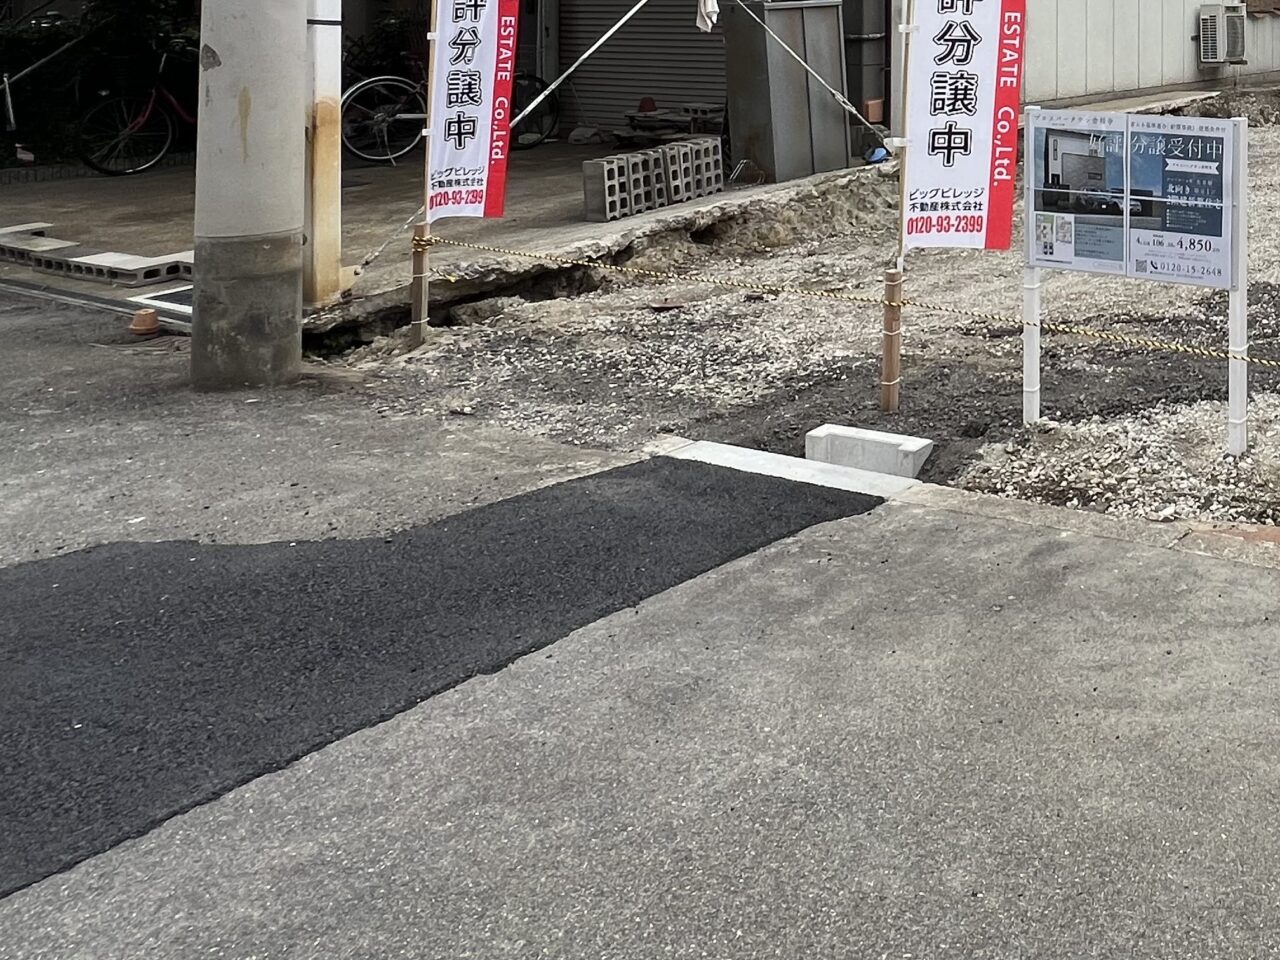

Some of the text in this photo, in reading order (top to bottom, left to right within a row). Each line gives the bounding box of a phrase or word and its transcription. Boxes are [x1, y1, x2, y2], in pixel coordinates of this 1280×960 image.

[497, 16, 515, 81] ESTATE
[1000, 13, 1020, 87] ESTATE
[993, 106, 1014, 186] Co.,Ltd.
[909, 187, 985, 201] ビッグビレッジ
[909, 200, 984, 213] 不動産株式会社
[907, 215, 983, 235] 0120-93-2399
[1177, 236, 1212, 252] 4,850
[1160, 262, 1222, 277] 0120-15-2648
